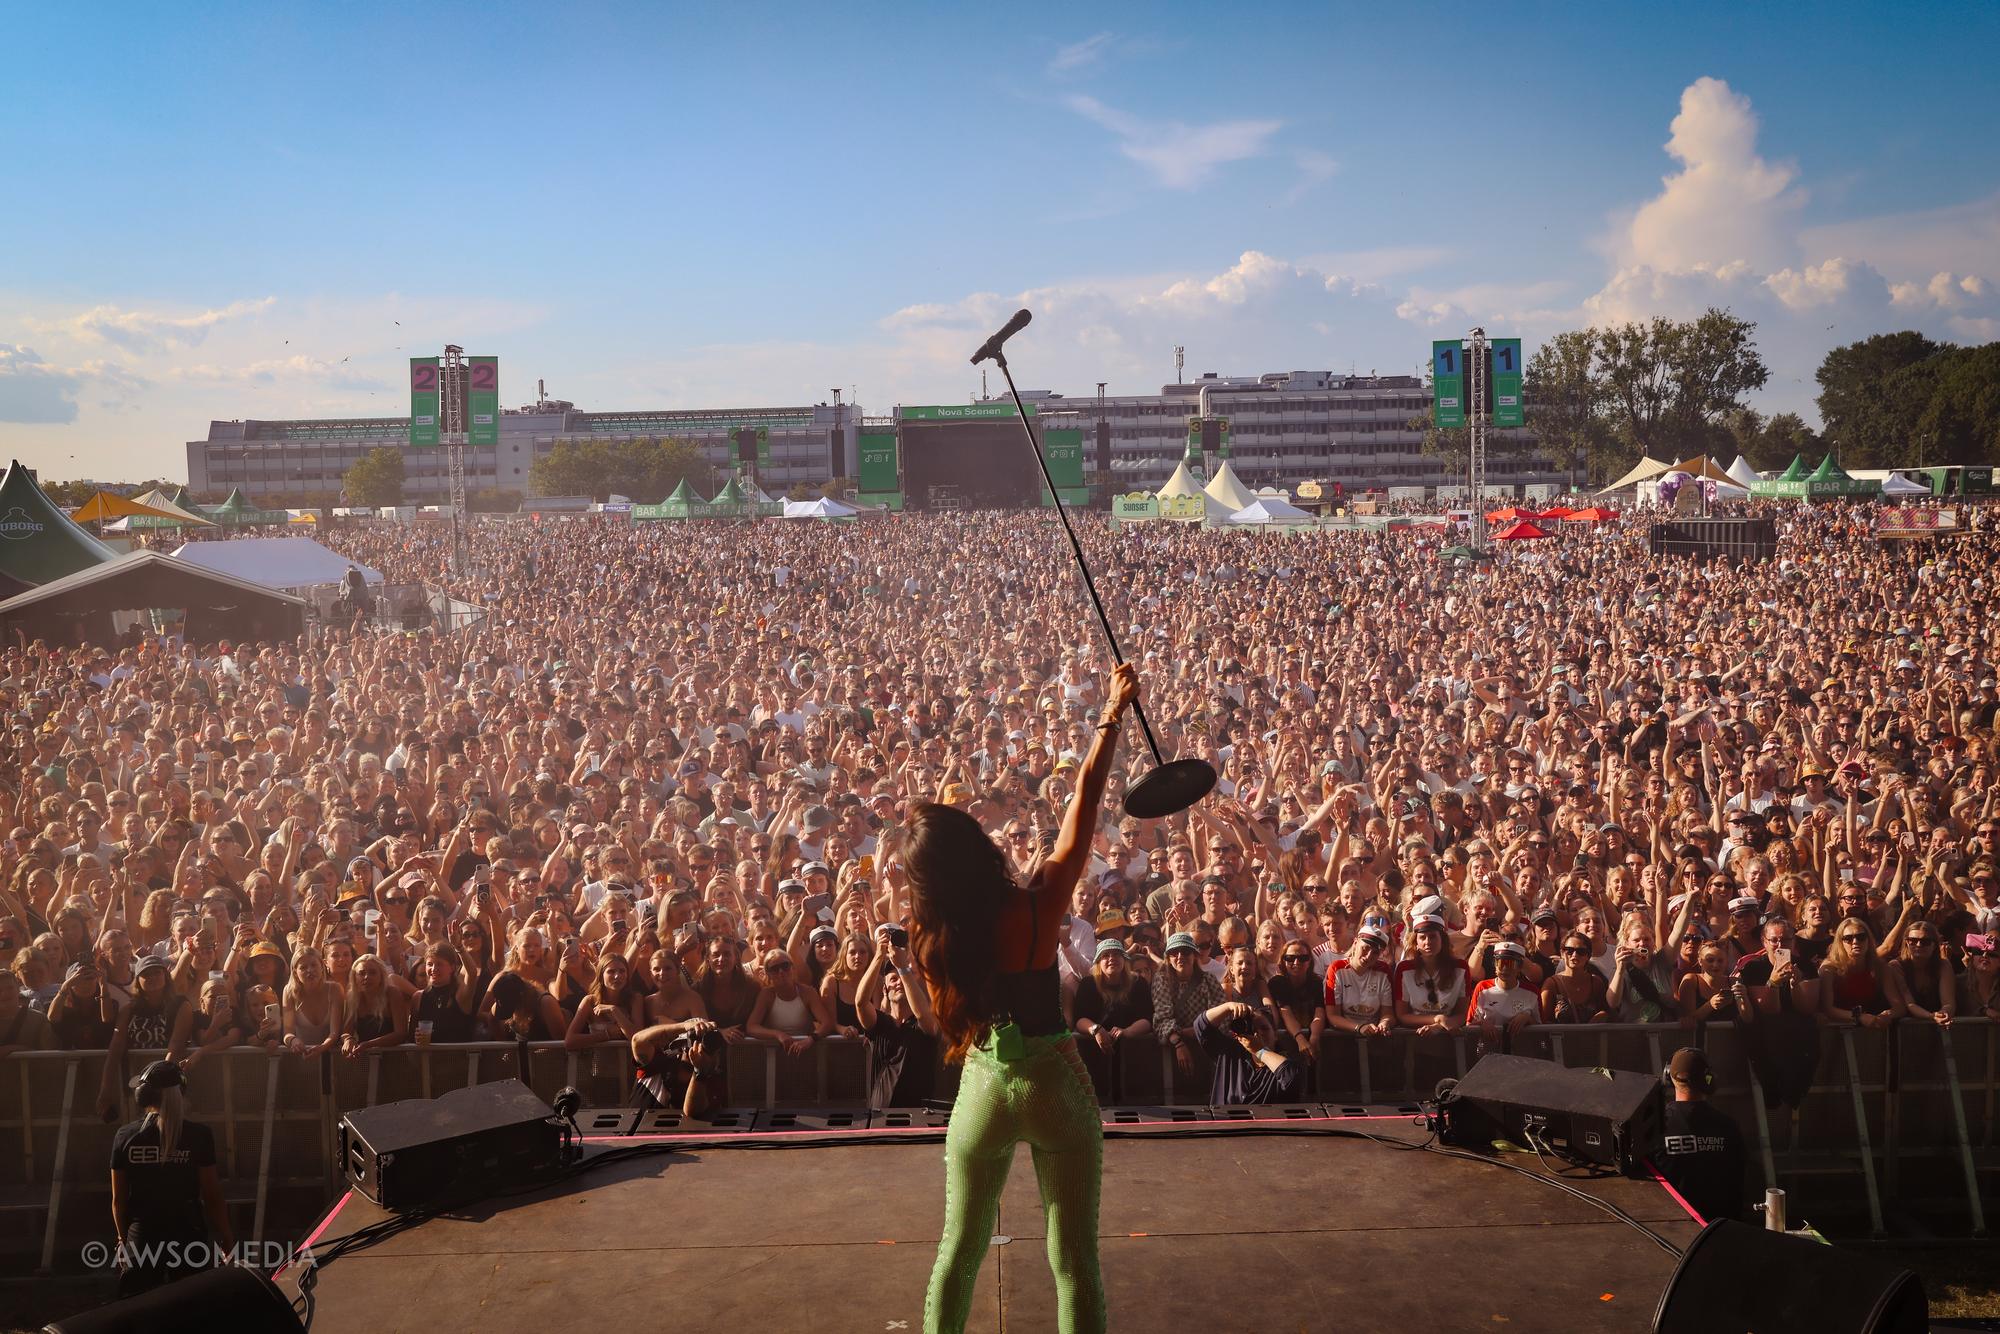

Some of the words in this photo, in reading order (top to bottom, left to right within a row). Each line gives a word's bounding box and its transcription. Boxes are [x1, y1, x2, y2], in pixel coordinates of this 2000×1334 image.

[1441, 349, 1453, 372] 1
[1499, 347, 1512, 370] 1
[414, 366, 435, 389] 2
[472, 365, 494, 389] 2
[938, 408, 962, 416] Nova
[965, 407, 1001, 416] Scenen
[1191, 421, 1201, 432] 3
[1220, 421, 1227, 432] 3
[757, 430, 767, 441] 4
[1813, 482, 1840, 492] BAR
[637, 505, 656, 516] BAR
[694, 505, 711, 515] BAR
[241, 513, 260, 522] BAR
[0, 522, 43, 531] UBORG
[1697, 1136, 1725, 1145] EVENT
[1698, 1144, 1725, 1152] SAFETY
